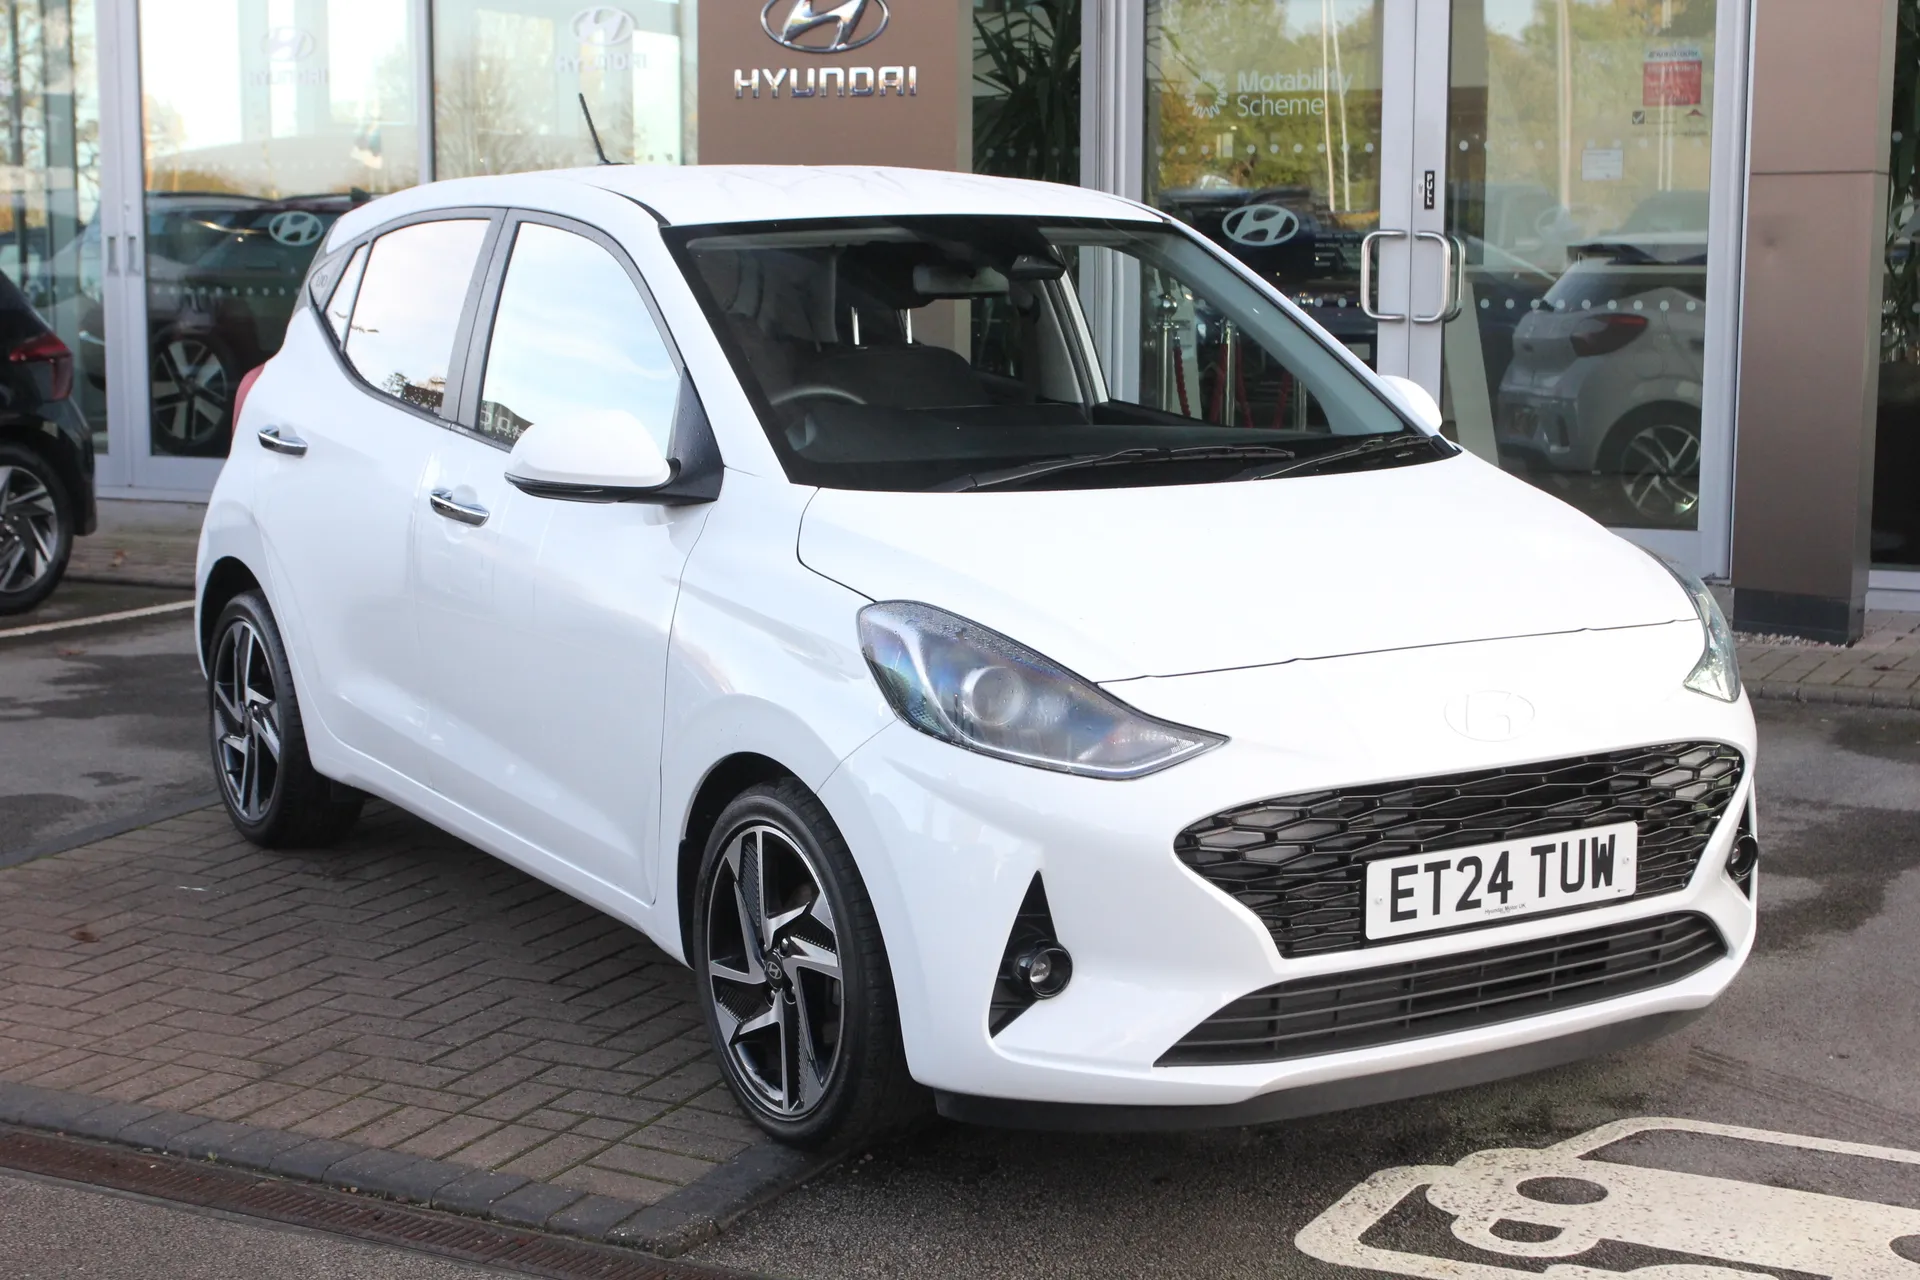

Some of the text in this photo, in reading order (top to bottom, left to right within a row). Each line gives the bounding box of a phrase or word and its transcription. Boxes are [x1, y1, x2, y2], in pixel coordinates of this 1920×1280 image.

[733, 65, 917, 99] HYUNDAI
[1237, 67, 1353, 95] Motability
[1237, 94, 1325, 117] Scheme
[1426, 173, 1434, 206] PULL
[1390, 833, 1616, 922] ET24 TUW
